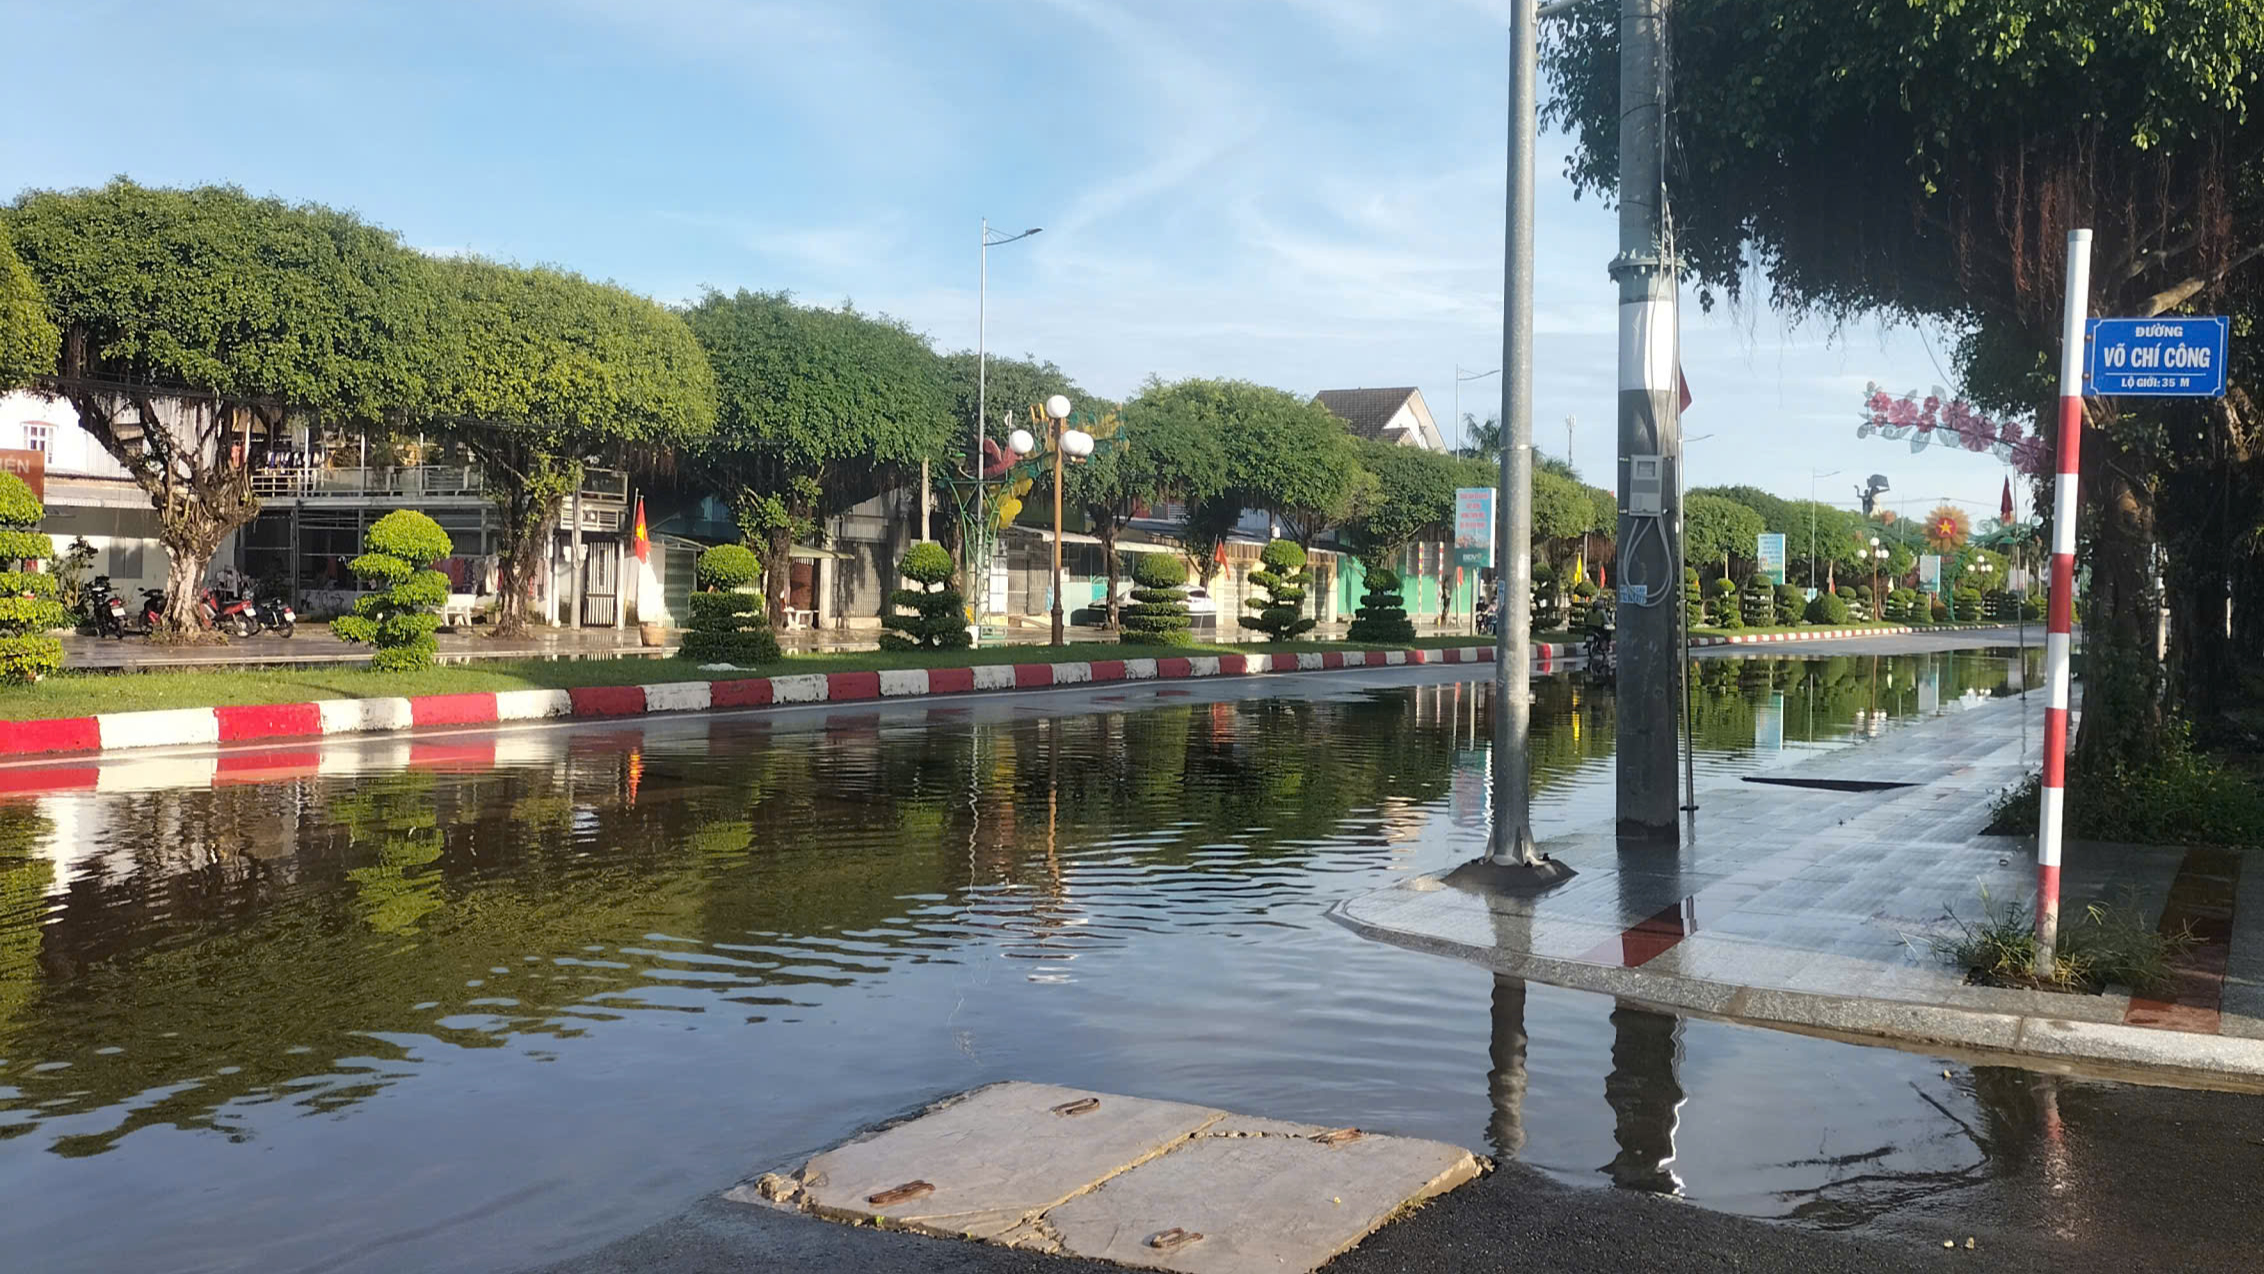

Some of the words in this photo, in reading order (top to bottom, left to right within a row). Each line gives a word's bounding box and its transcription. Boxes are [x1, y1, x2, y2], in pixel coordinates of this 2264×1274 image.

[2135, 323, 2183, 337] ĐƯỜNG
[2104, 343, 2126, 368] VÕ
[2131, 342, 2161, 368] CHÍ
[2164, 342, 2211, 368] CÔNG
[2121, 377, 2134, 389] LỘ
[2136, 376, 2160, 387] GIỚI:
[2161, 378, 2176, 387] 35
[2180, 378, 2190, 387] M
